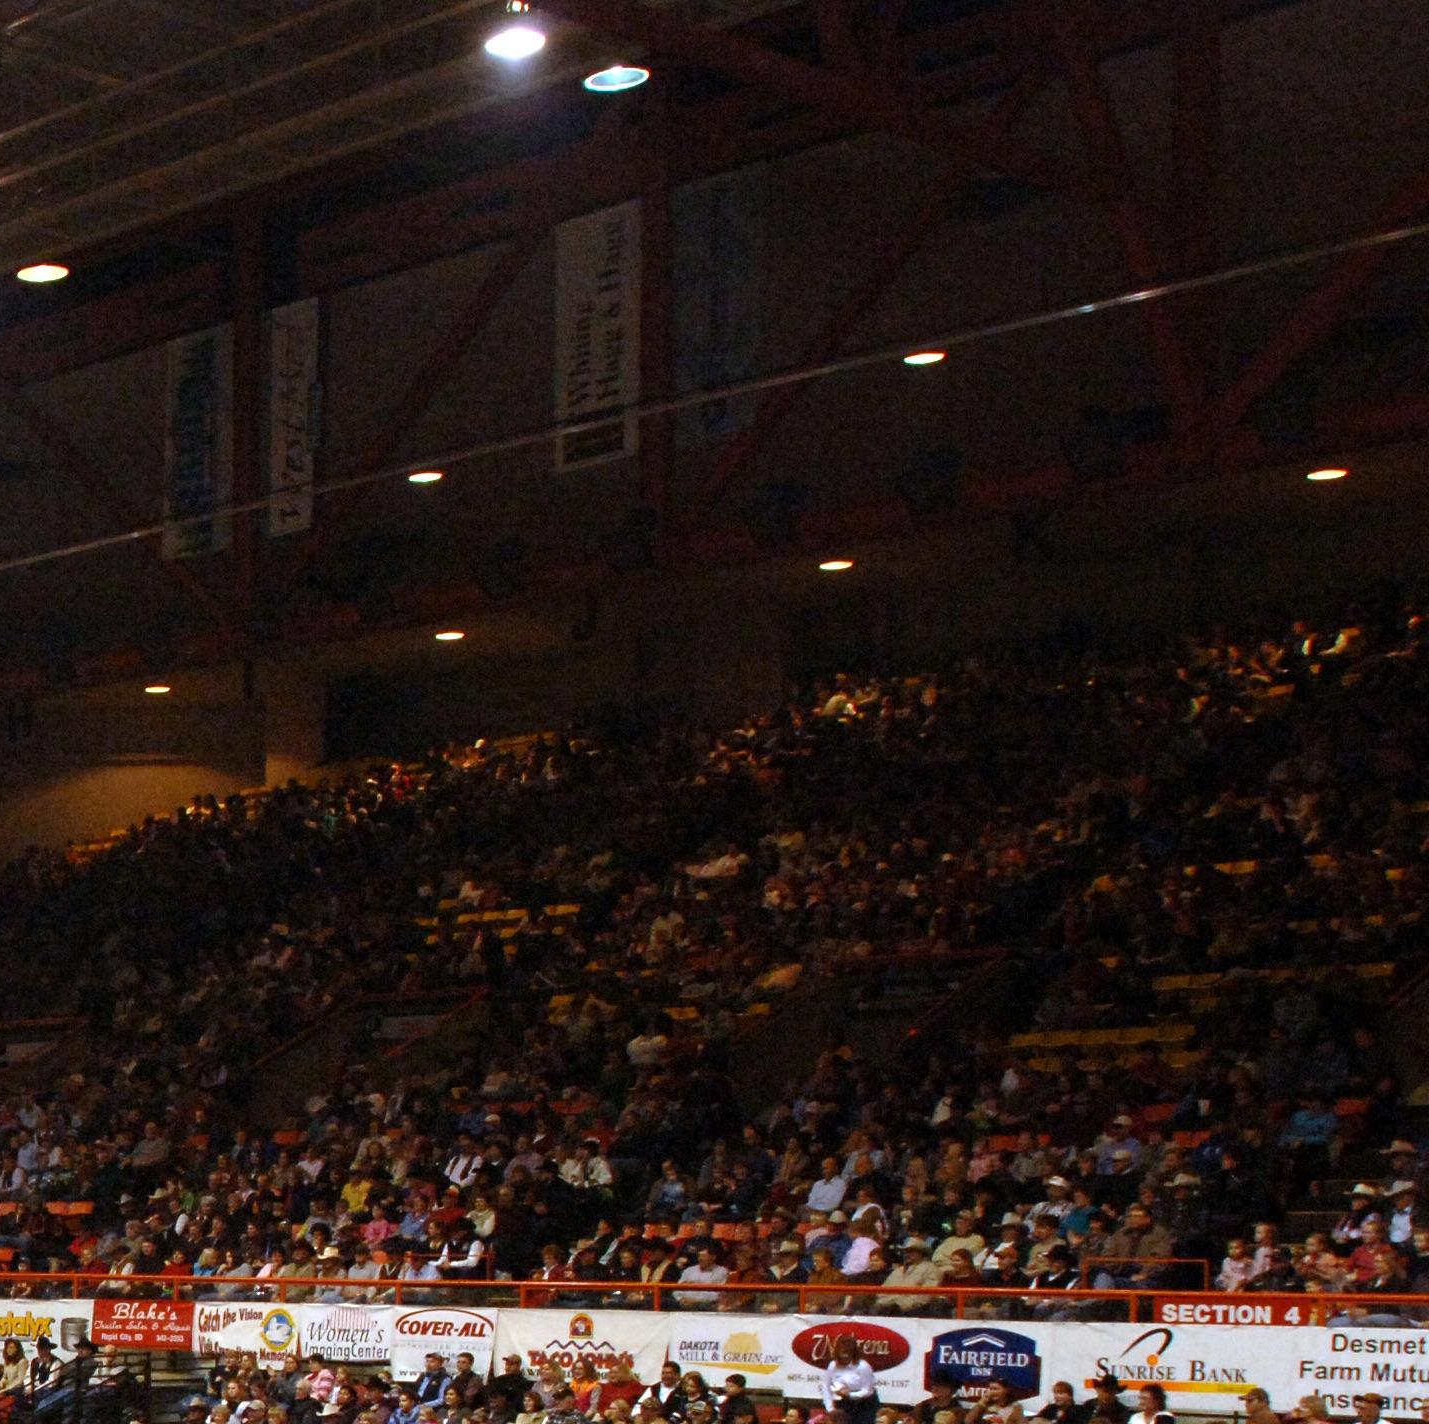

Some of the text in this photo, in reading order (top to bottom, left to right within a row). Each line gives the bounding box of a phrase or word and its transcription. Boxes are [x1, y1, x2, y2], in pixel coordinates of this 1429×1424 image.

[112, 1302, 178, 1320] Blake's
[198, 1307, 263, 1333] Catch the Vision
[1162, 1304, 1300, 1325] SECTION 4
[309, 1320, 384, 1343] Women's
[398, 1320, 487, 1338] COVER-ALL
[679, 1341, 720, 1350] DAKOTA
[1332, 1333, 1427, 1355] Desmet
[528, 1351, 572, 1368] TACO
[679, 1352, 709, 1361] MILL
[711, 1352, 719, 1361] &
[938, 1345, 1029, 1368] FAIRFIELD
[971, 1367, 991, 1376] INN
[1096, 1358, 1247, 1383] SUNRISE BANK
[1300, 1360, 1361, 1381] Farm
